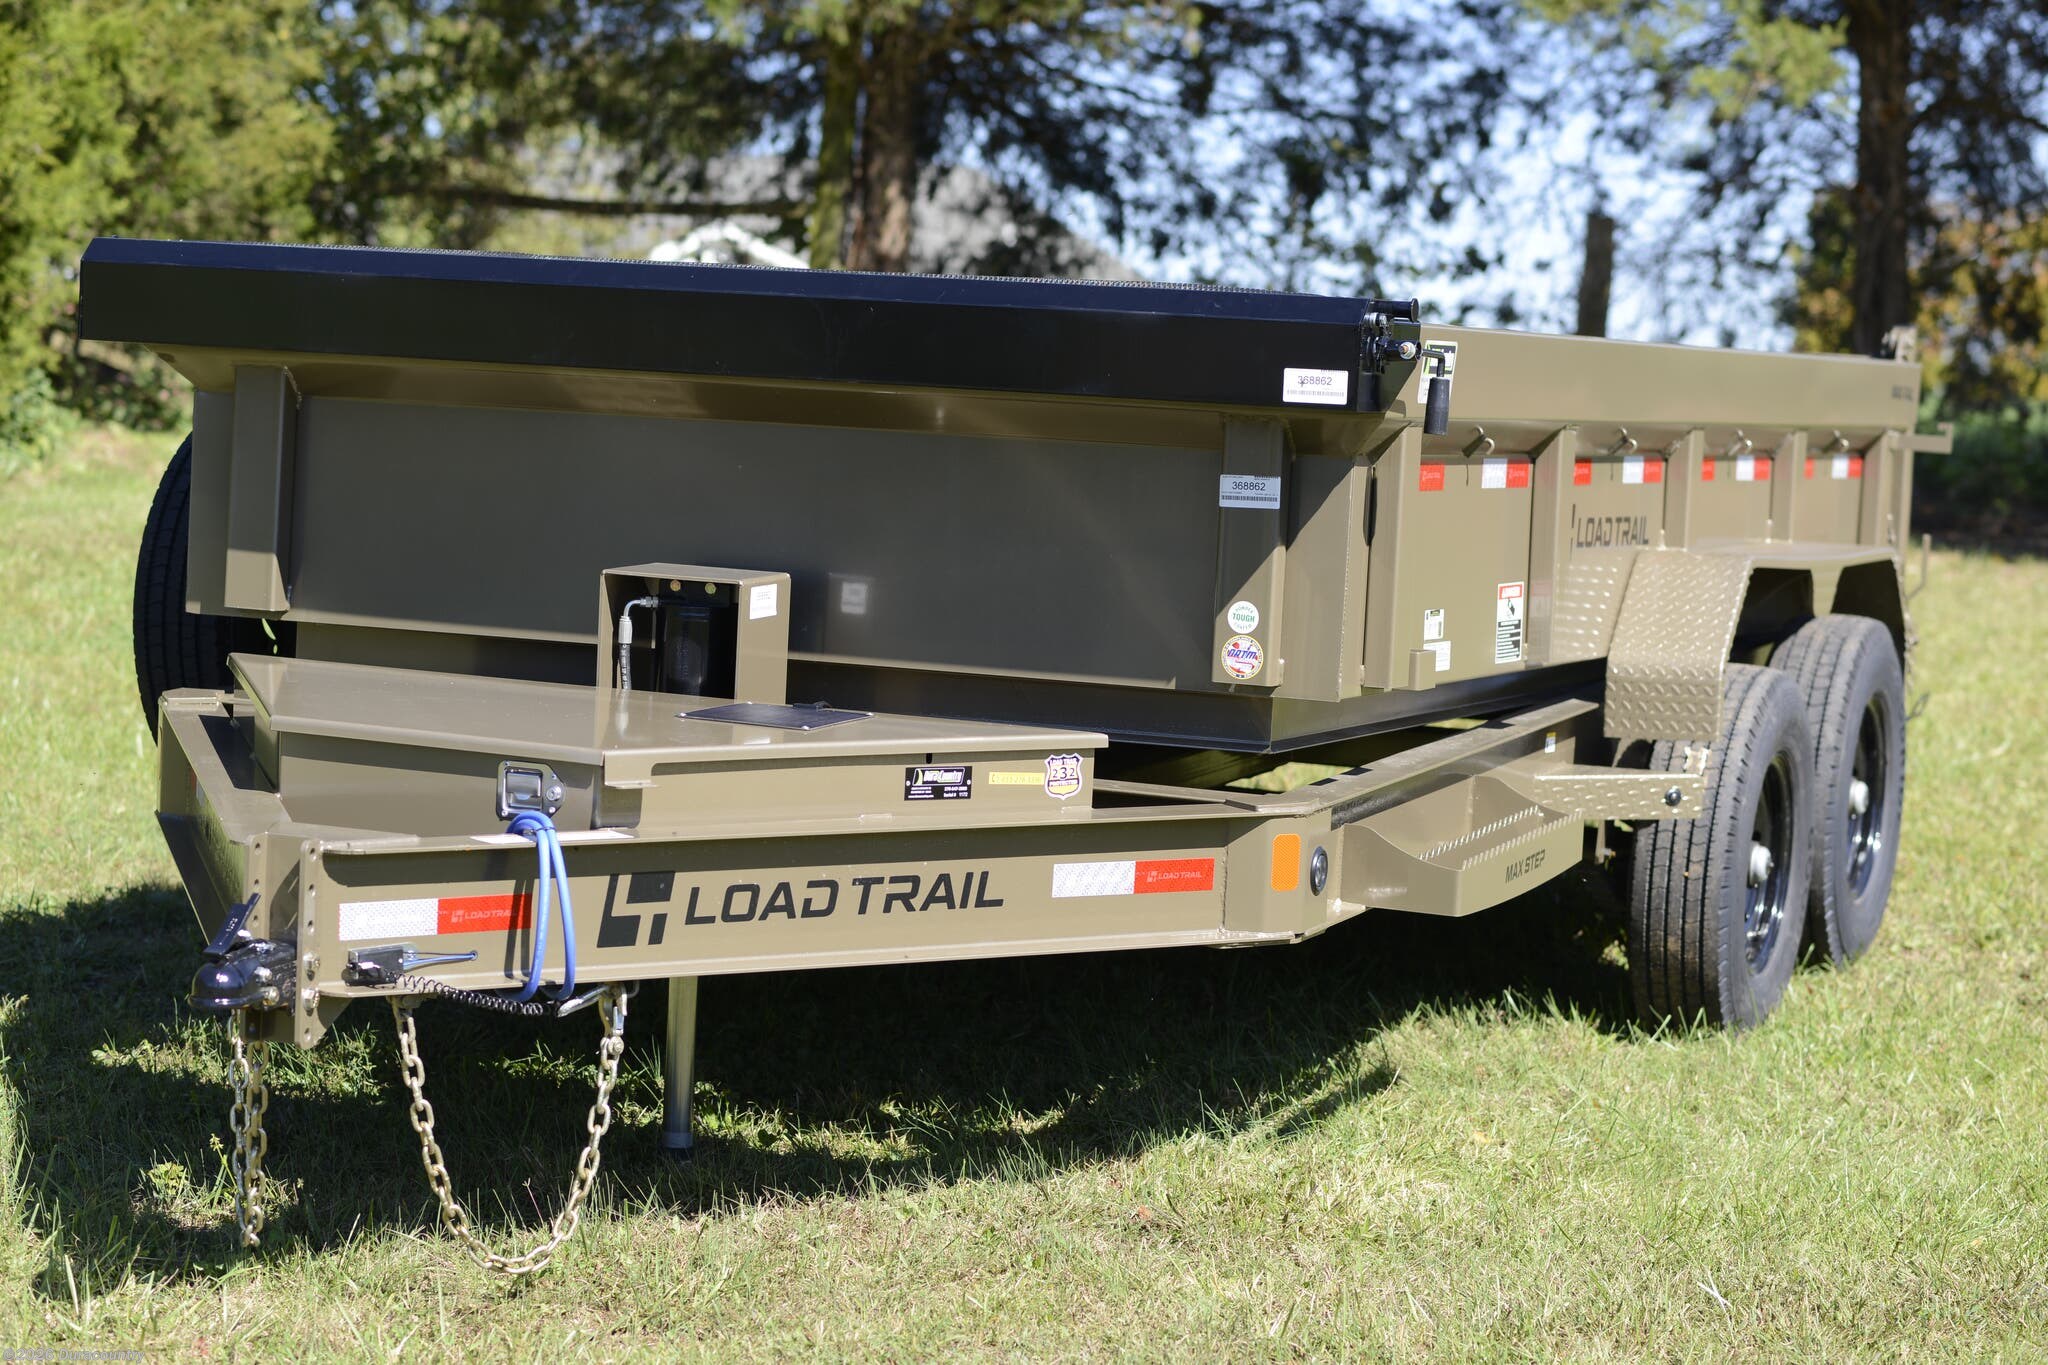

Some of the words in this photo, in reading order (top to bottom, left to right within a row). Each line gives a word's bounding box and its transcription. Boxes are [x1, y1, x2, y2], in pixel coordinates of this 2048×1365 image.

[1298, 375, 1332, 386] 368862
[1232, 481, 1266, 491] 368862
[1576, 517, 1612, 548] LOAD
[1615, 515, 1649, 545] TRAIL
[1232, 613, 1255, 623] TOUGH
[1505, 859, 1524, 884] MAX
[1524, 849, 1546, 874] STEP
[684, 878, 839, 925] LOAD
[851, 870, 1004, 915] TRAIL
[464, 911, 489, 920] LOAD
